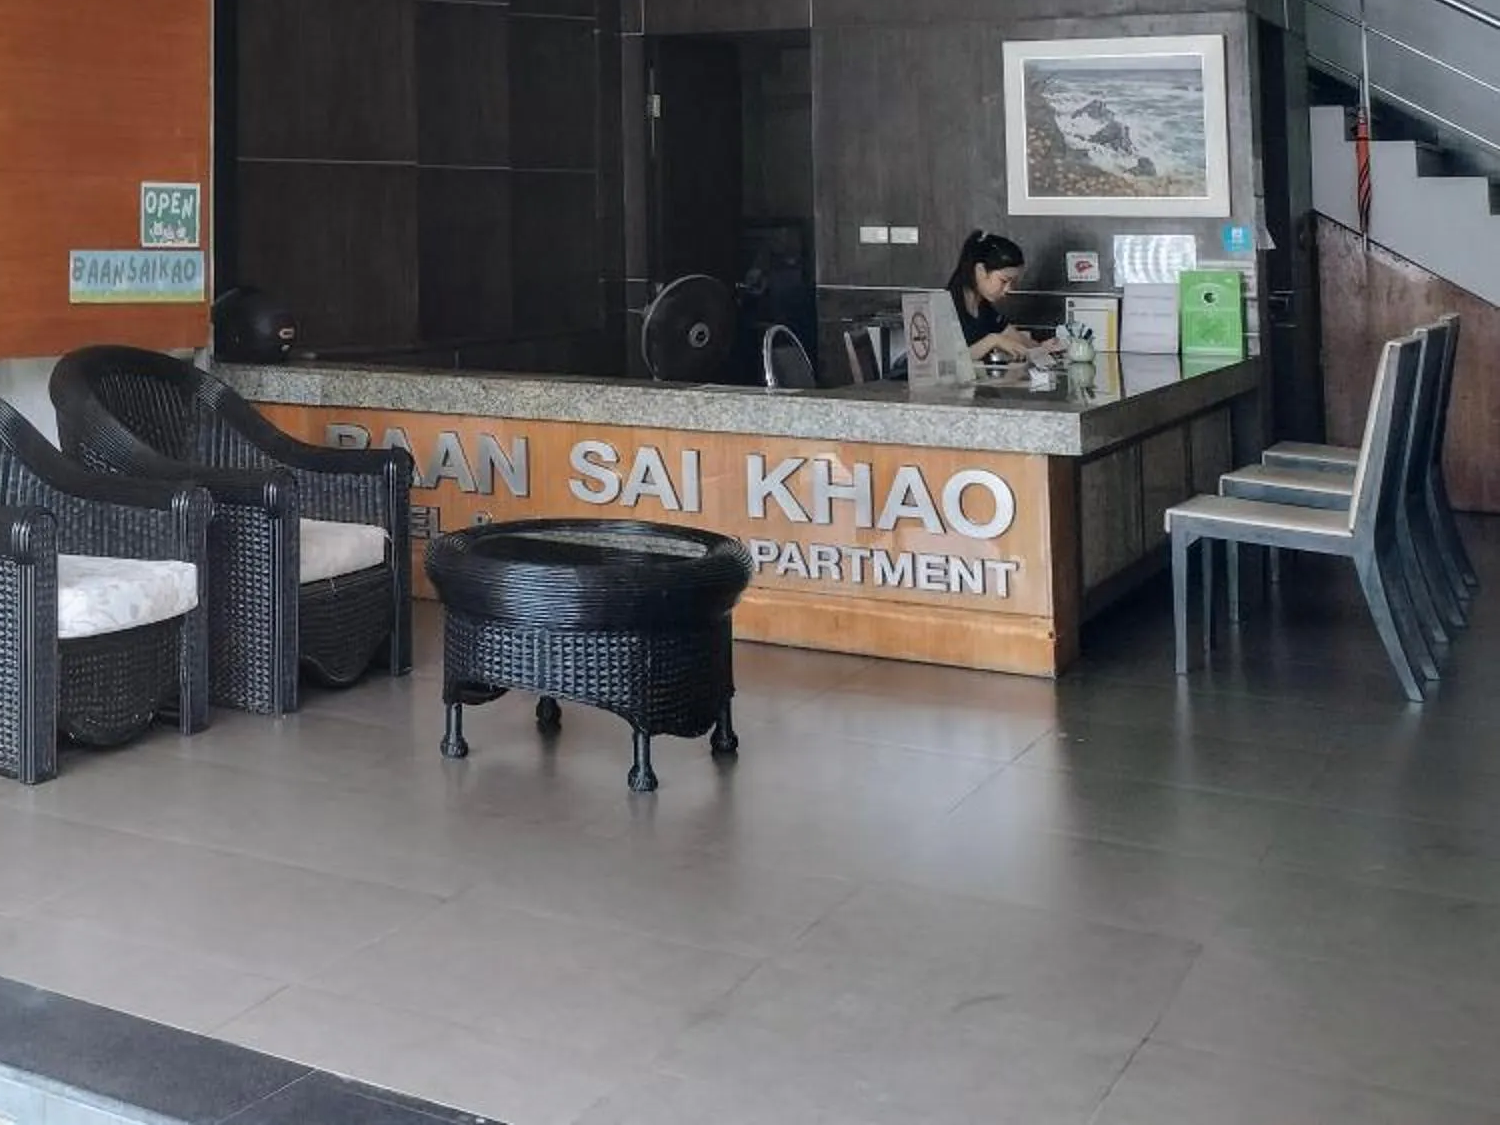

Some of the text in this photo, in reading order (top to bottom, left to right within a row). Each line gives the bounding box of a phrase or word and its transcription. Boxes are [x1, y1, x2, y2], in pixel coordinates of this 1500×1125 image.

[145, 191, 194, 220] OPEN
[567, 440, 701, 513] SAI
[746, 452, 1017, 540] KHAO
[749, 537, 1020, 598] PARTMENT
